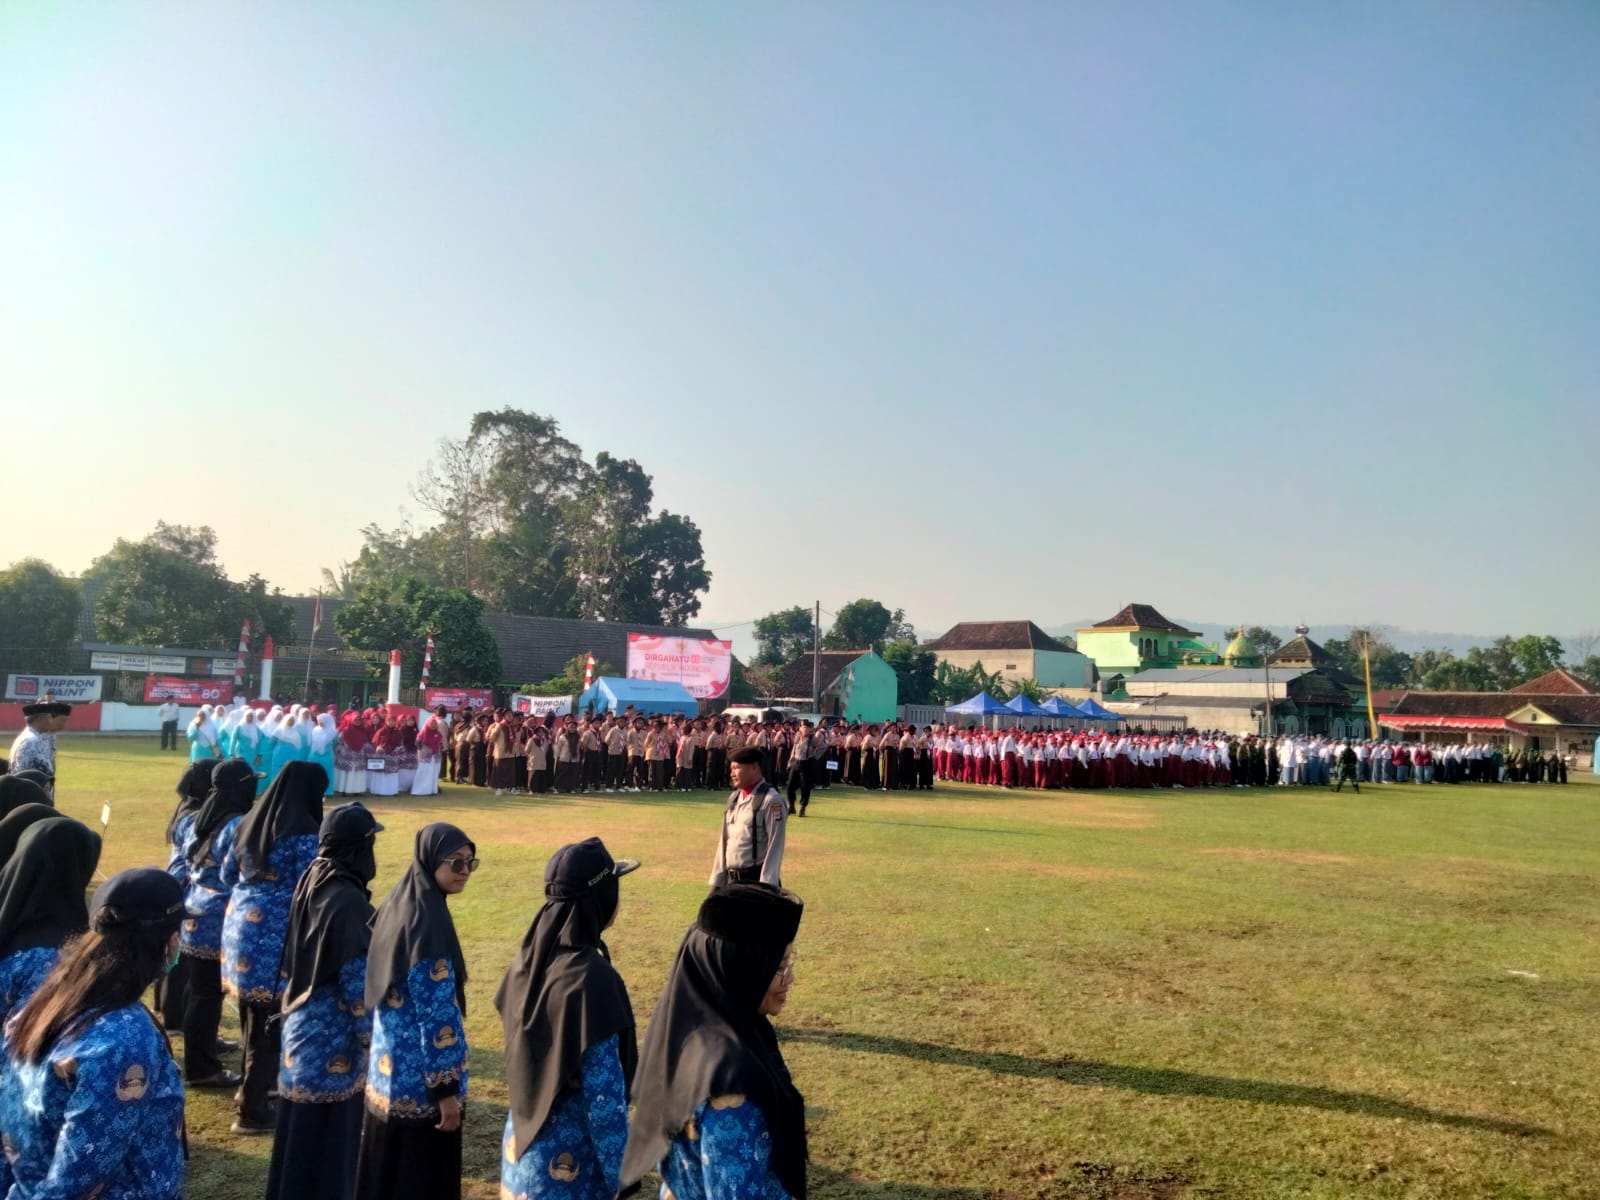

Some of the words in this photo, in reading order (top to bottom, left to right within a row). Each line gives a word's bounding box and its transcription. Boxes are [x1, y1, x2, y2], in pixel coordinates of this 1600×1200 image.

[645, 653, 690, 663] DIRGAHAYU
[43, 679, 95, 687] NIPPON
[49, 688, 87, 697] PAINT
[202, 689, 220, 700] 80
[534, 699, 566, 708] NIPPON
